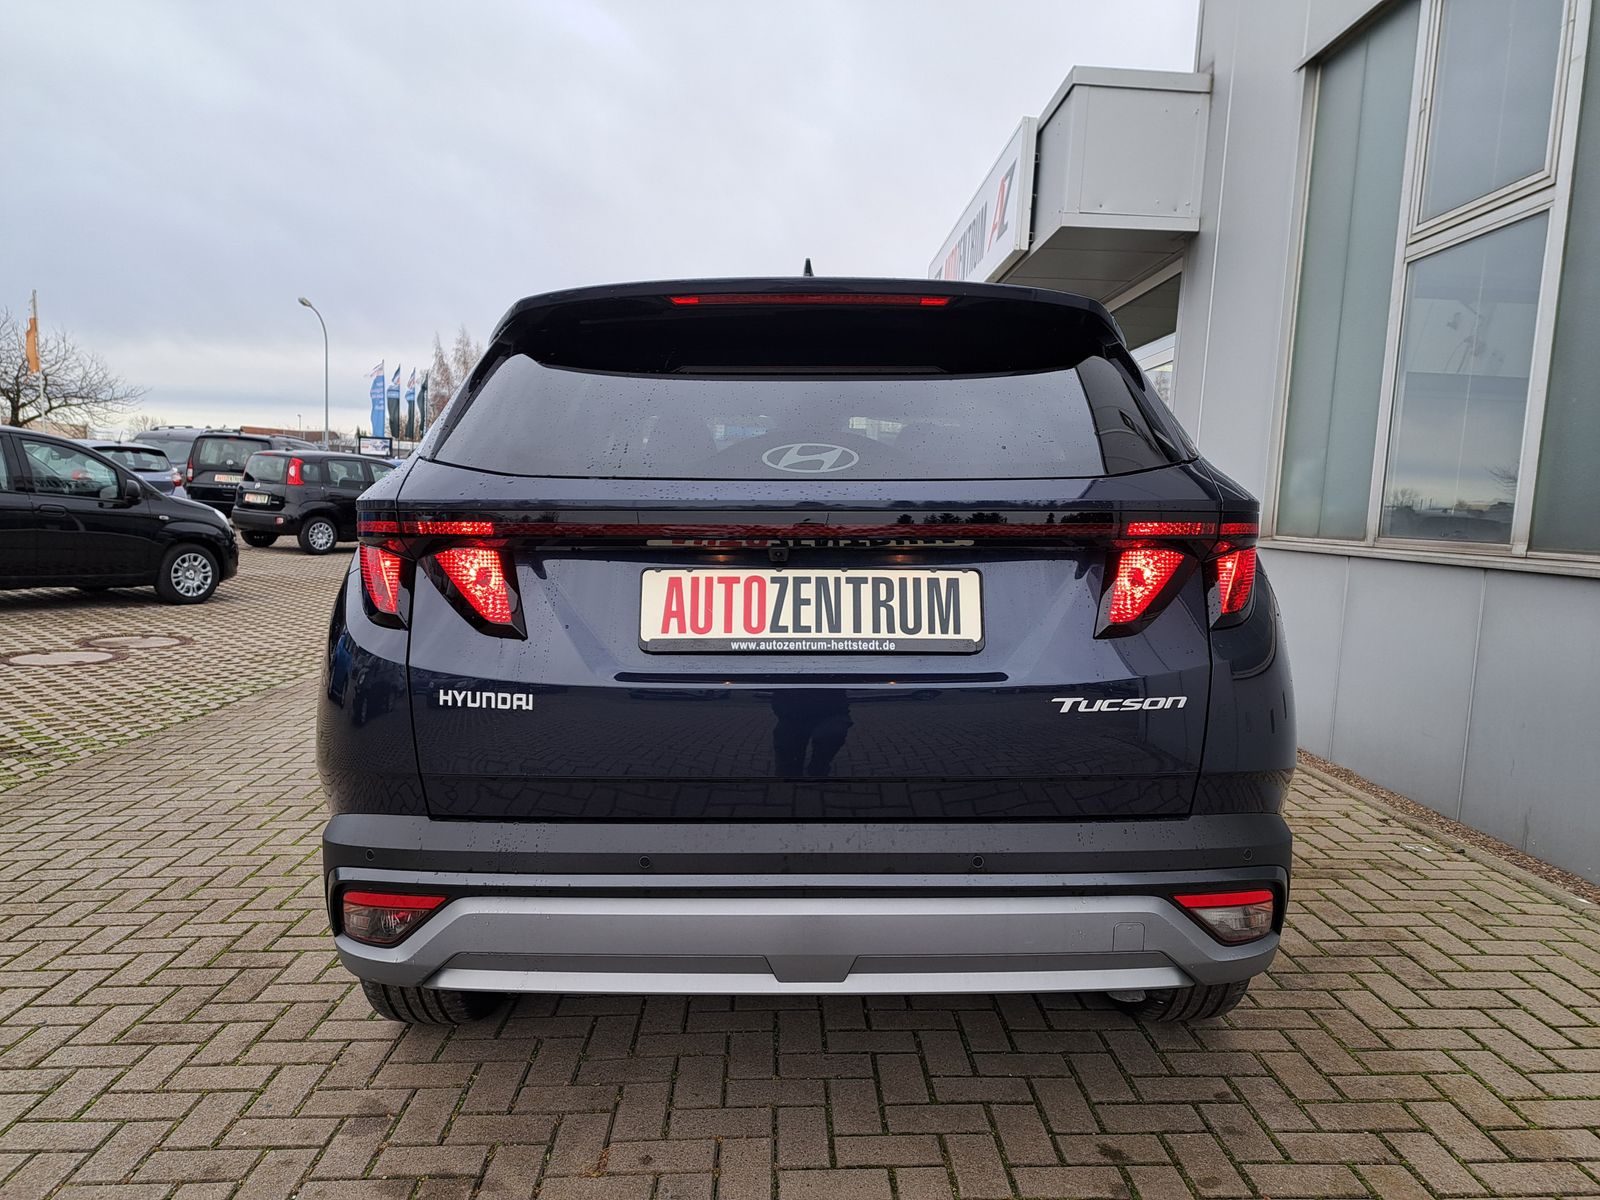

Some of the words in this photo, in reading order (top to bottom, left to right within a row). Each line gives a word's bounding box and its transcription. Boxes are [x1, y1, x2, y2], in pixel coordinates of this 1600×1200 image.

[660, 575, 962, 636] AUTOZENTRUM
[730, 639, 896, 650] www.autozentrum-hettstedt.de
[439, 689, 533, 710] HYUNDAI
